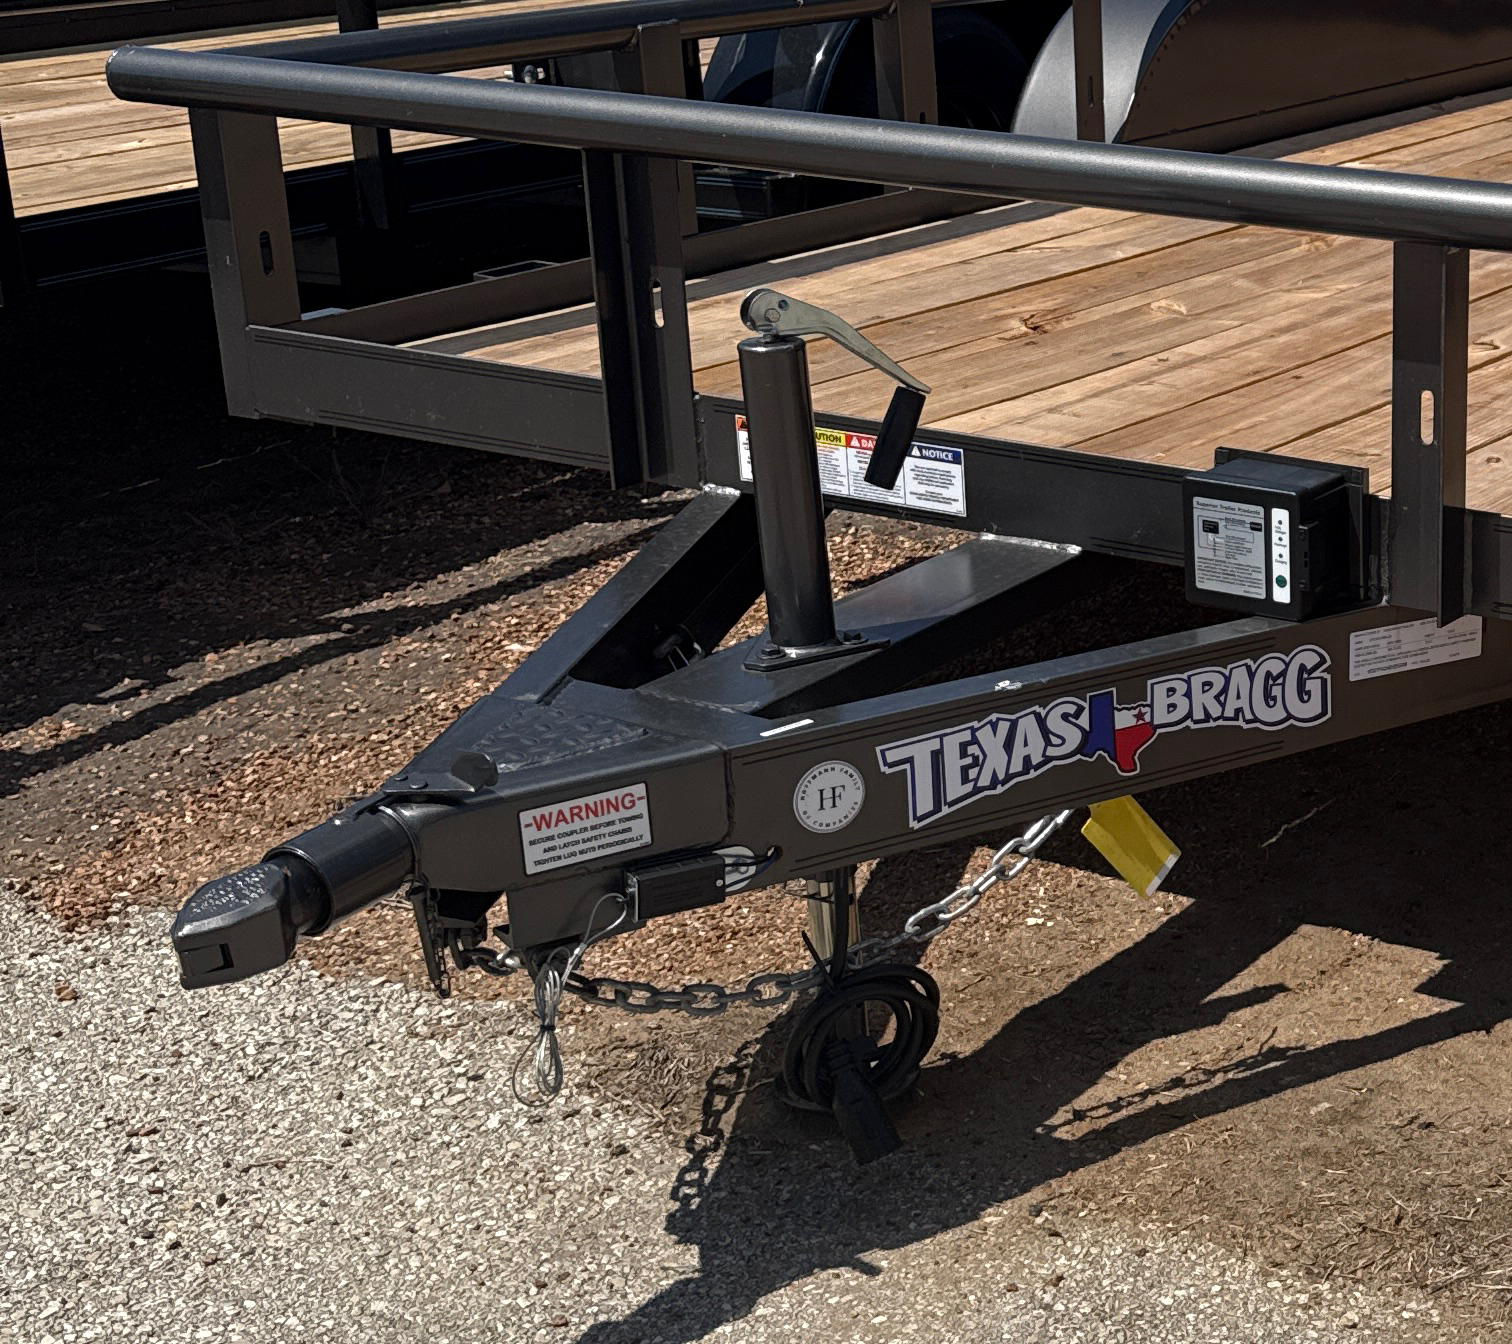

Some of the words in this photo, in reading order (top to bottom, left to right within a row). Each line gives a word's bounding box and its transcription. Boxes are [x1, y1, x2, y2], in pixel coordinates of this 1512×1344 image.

[815, 431, 842, 444] UTION
[922, 448, 954, 462] NOTICE
[878, 698, 1088, 826] TEXAS
[1149, 646, 1331, 730] BRAGG
[817, 784, 846, 812] HF
[556, 827, 589, 840] COUPLER
[543, 844, 557, 854] AND
[581, 833, 607, 845] SAFETY
